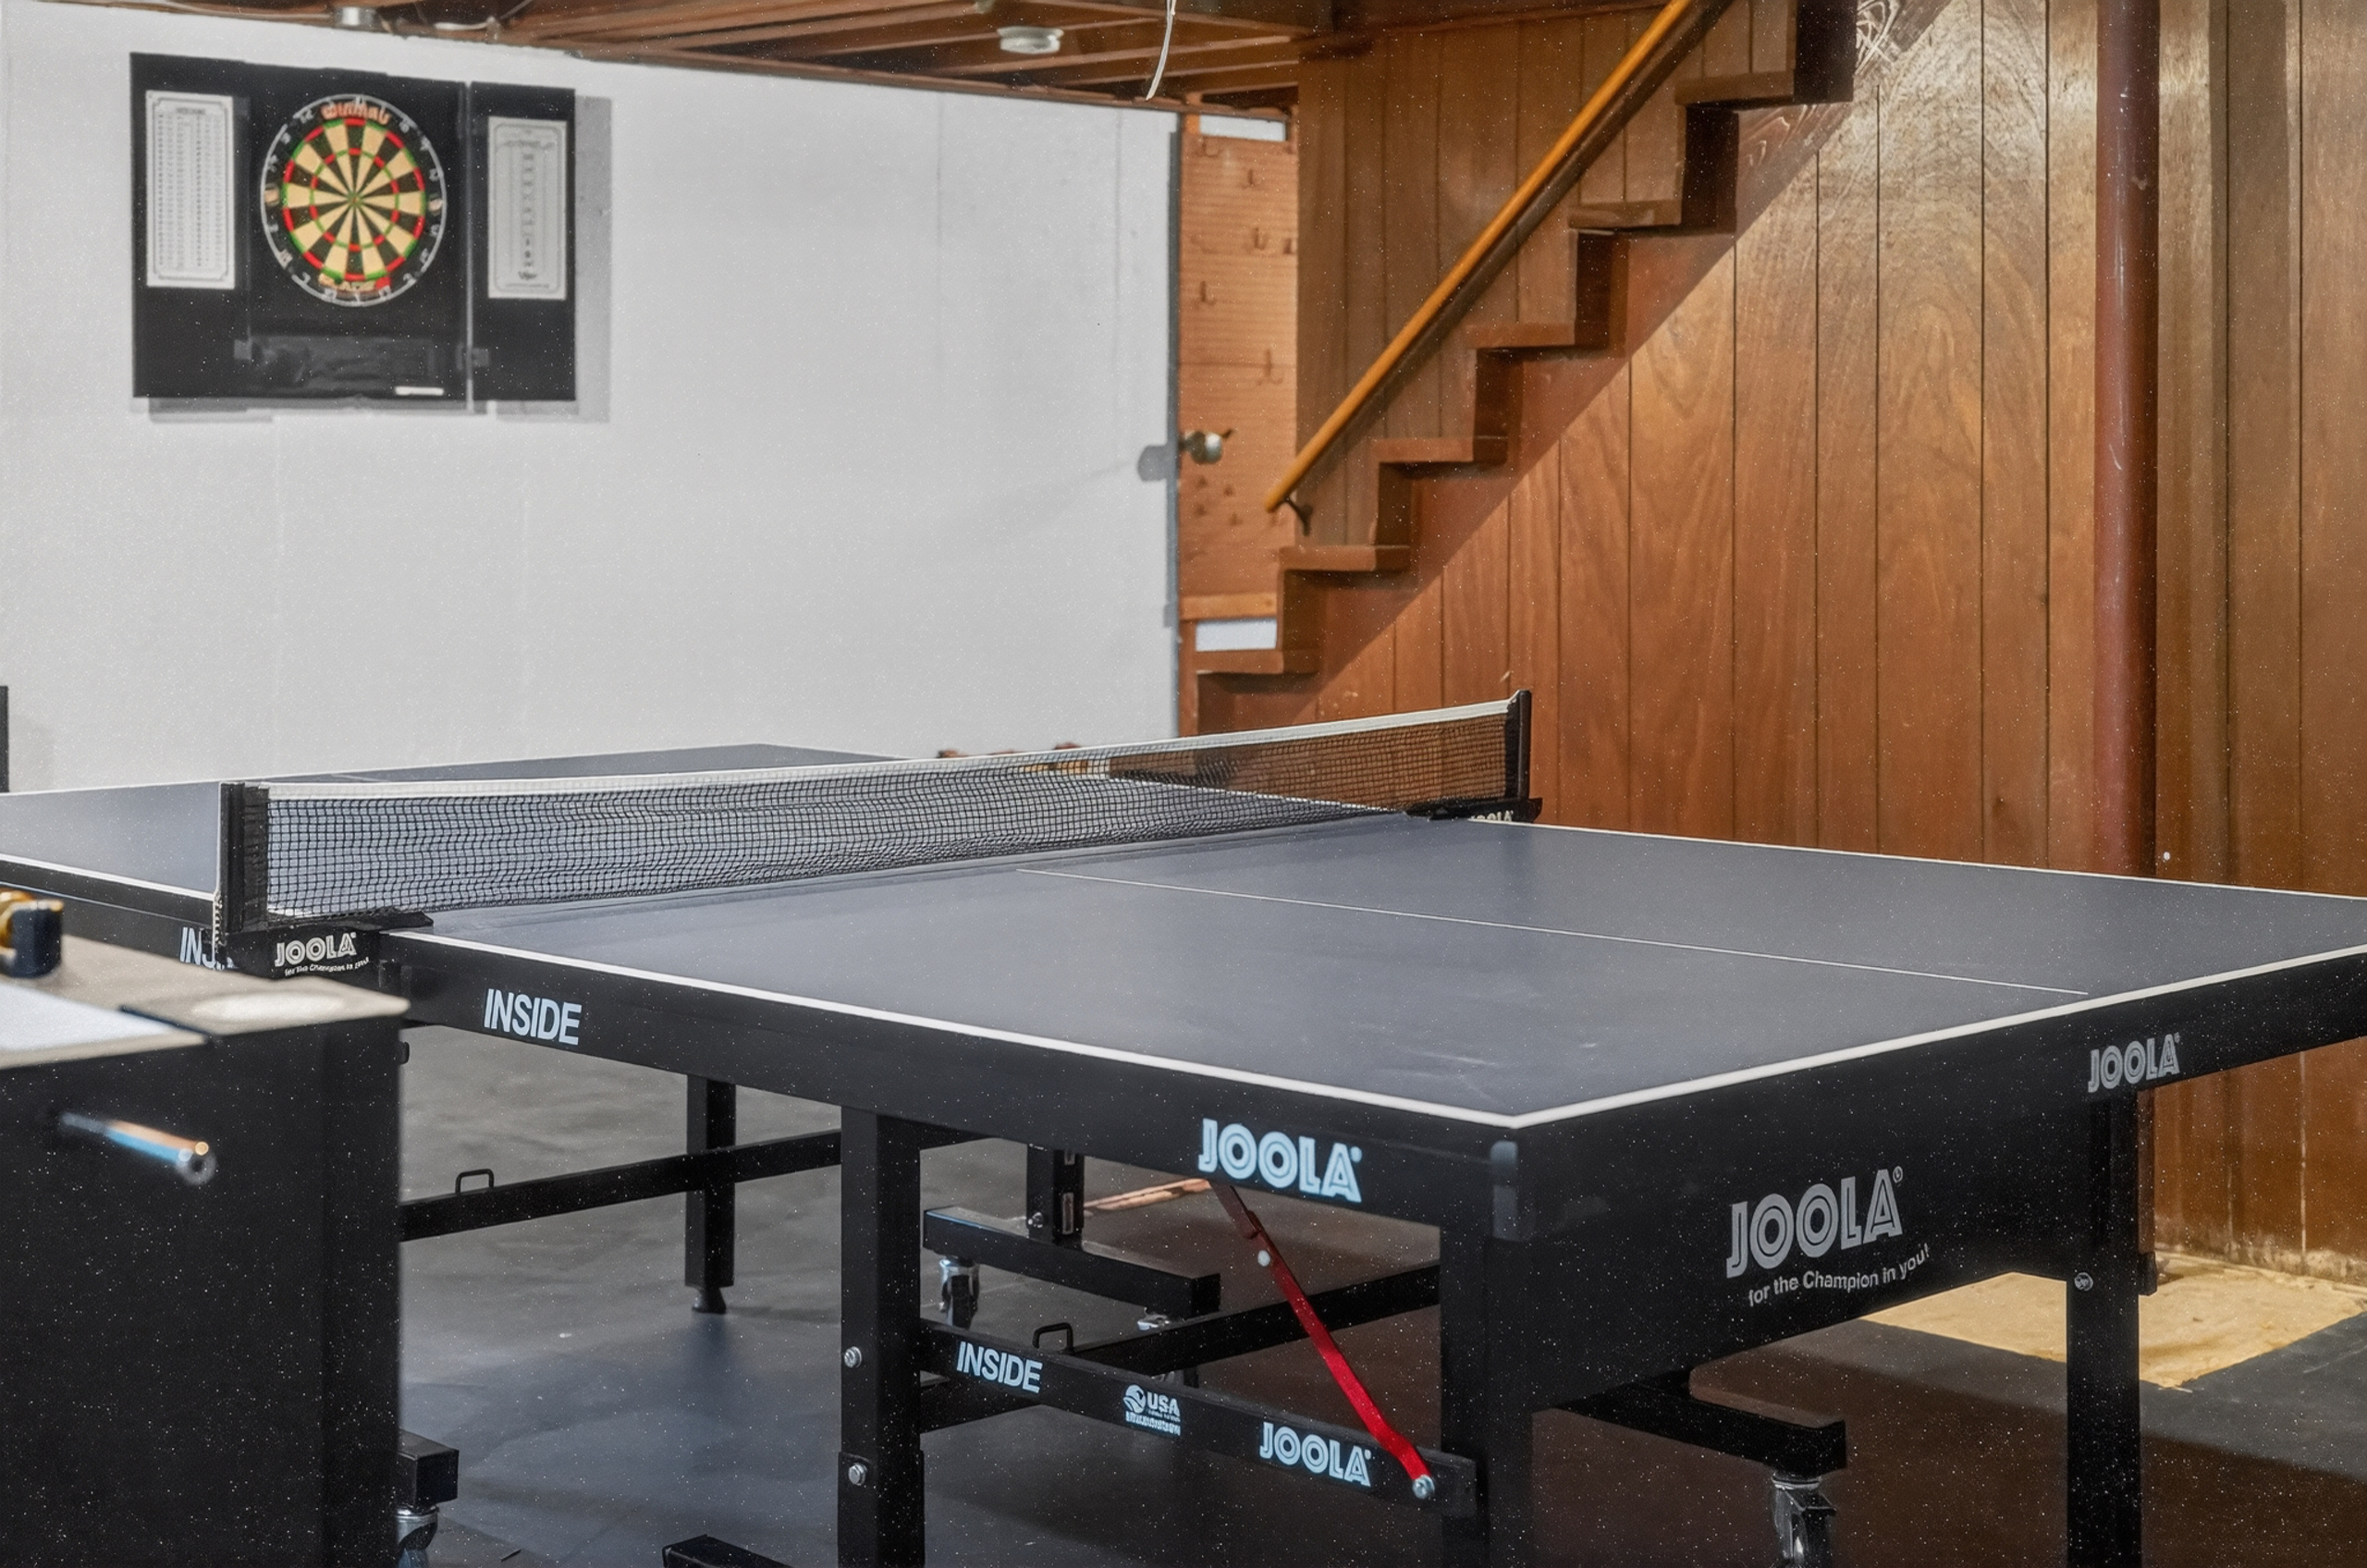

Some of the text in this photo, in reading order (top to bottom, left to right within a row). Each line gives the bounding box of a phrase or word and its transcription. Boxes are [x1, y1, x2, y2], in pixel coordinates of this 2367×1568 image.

[275, 932, 357, 967] JOOLA
[484, 988, 583, 1046] INSIDE
[2088, 1034, 2180, 1093] JOOLA
[1198, 1118, 1363, 1203] JOOLA
[1726, 1168, 1903, 1279] JOOLA
[1748, 1243, 1932, 1307] for the Champion in you!
[956, 1341, 1043, 1394] INSIDE
[1147, 1391, 1181, 1417] USA
[1259, 1422, 1371, 1488] JOOLA
